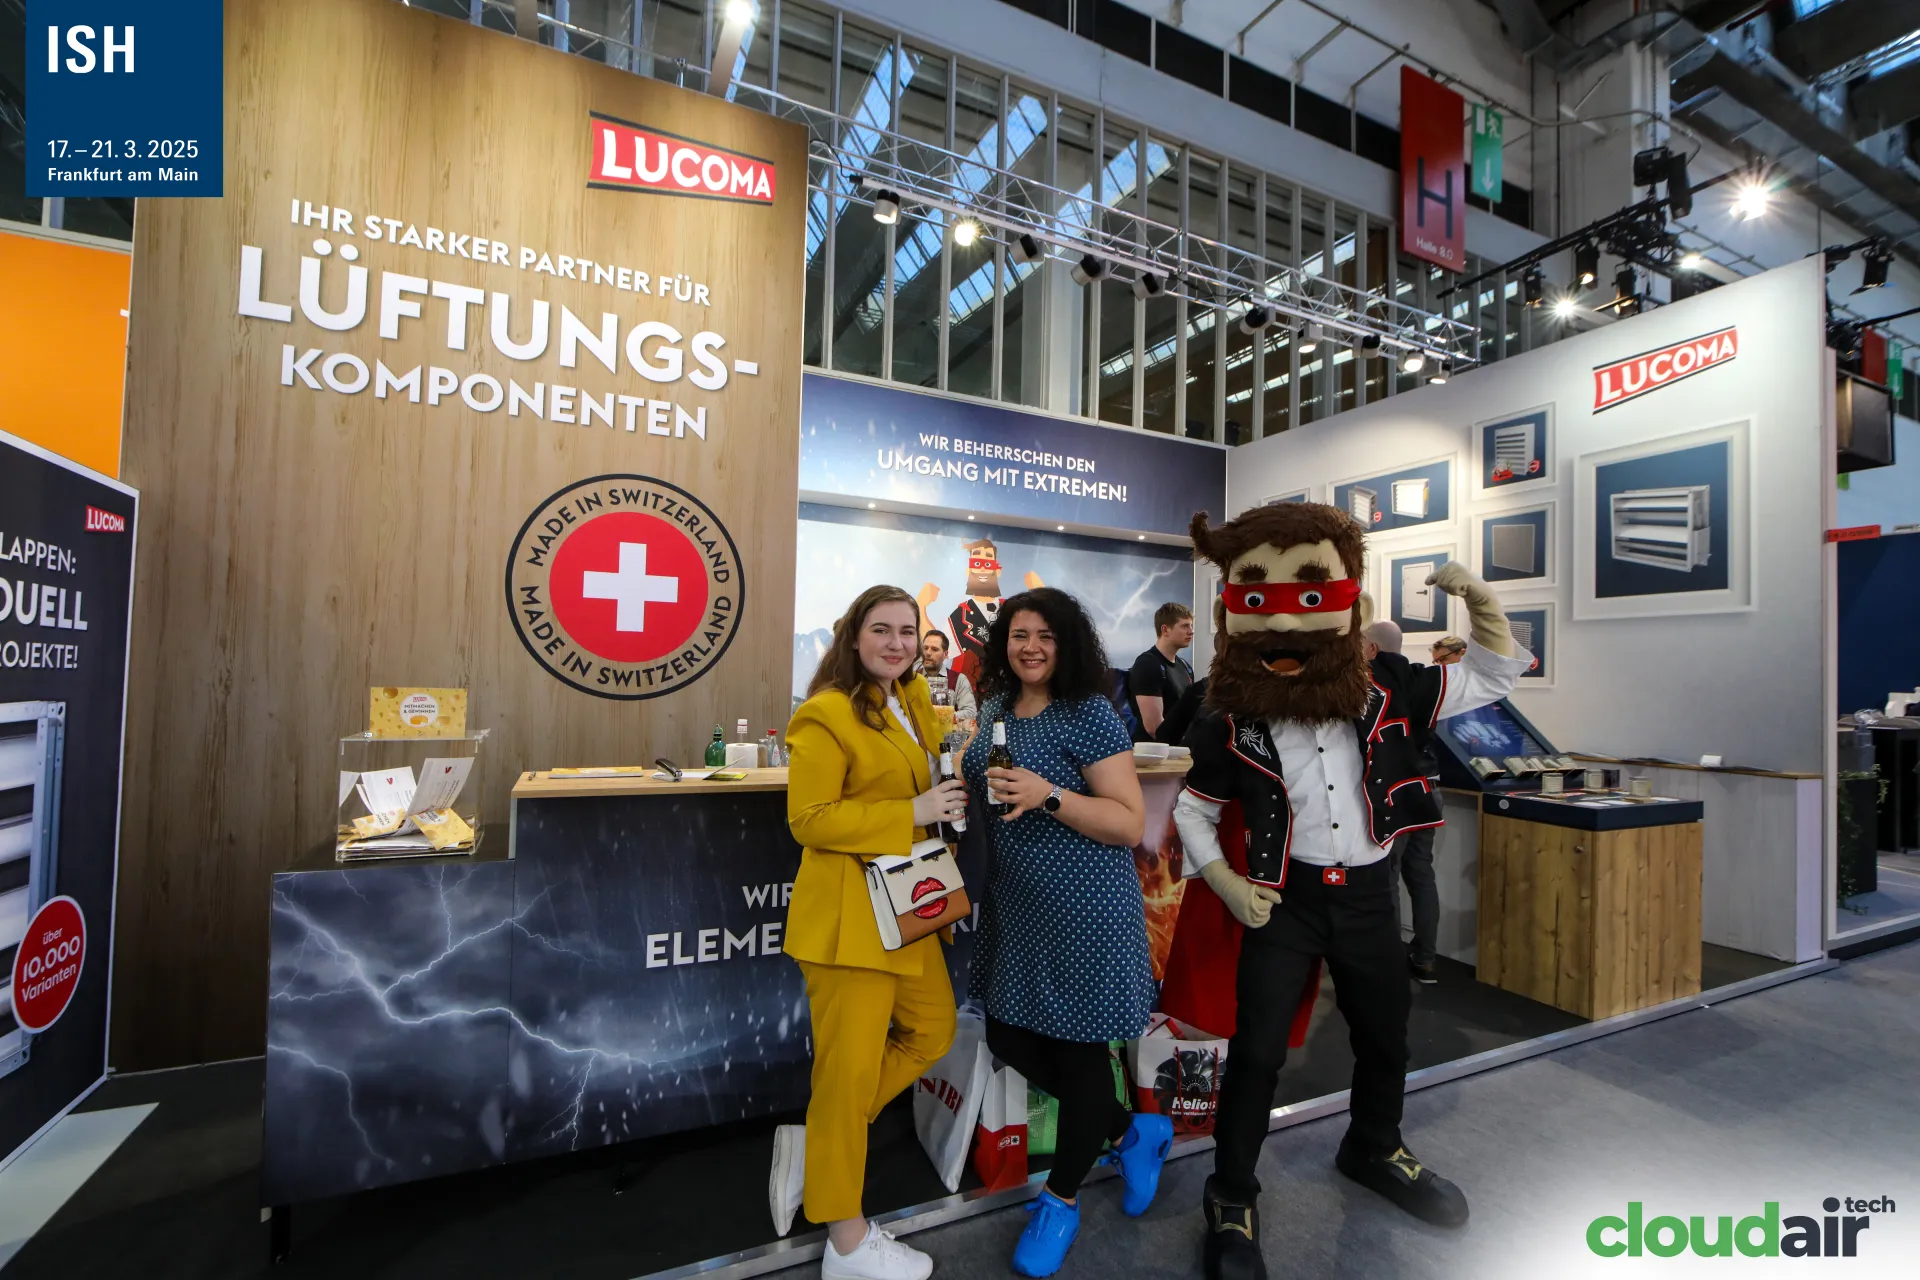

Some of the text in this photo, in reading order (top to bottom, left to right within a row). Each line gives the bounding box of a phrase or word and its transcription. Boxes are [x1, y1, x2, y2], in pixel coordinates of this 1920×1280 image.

[601, 128, 772, 199] LUCOMA
[1416, 156, 1453, 241] H
[291, 199, 711, 306] IHR STARKER PARTNER FÜR
[1416, 236, 1437, 255] Halle
[238, 238, 759, 391] LÜFTUNGS-
[1601, 333, 1735, 402] LUCOMA
[281, 344, 708, 441] KOMPONENTEN
[877, 449, 1127, 503] UMGANG MIT EXTREMEN!
[919, 432, 1096, 473] WIR BEHERRSCHEN DEN
[87, 508, 124, 532] LUCOMA
[526, 488, 730, 583] MADE IN SWITZERLAND
[0, 640, 78, 669] OJEKTE!
[520, 585, 732, 688] MADE IN SWITZERLAND
[741, 882, 795, 909] WIR
[23, 935, 80, 983] 10.000
[42, 928, 63, 945] über
[646, 923, 783, 969] ELEME
[22, 963, 77, 1002] Varianten
[1172, 1096, 1216, 1110] Helios
